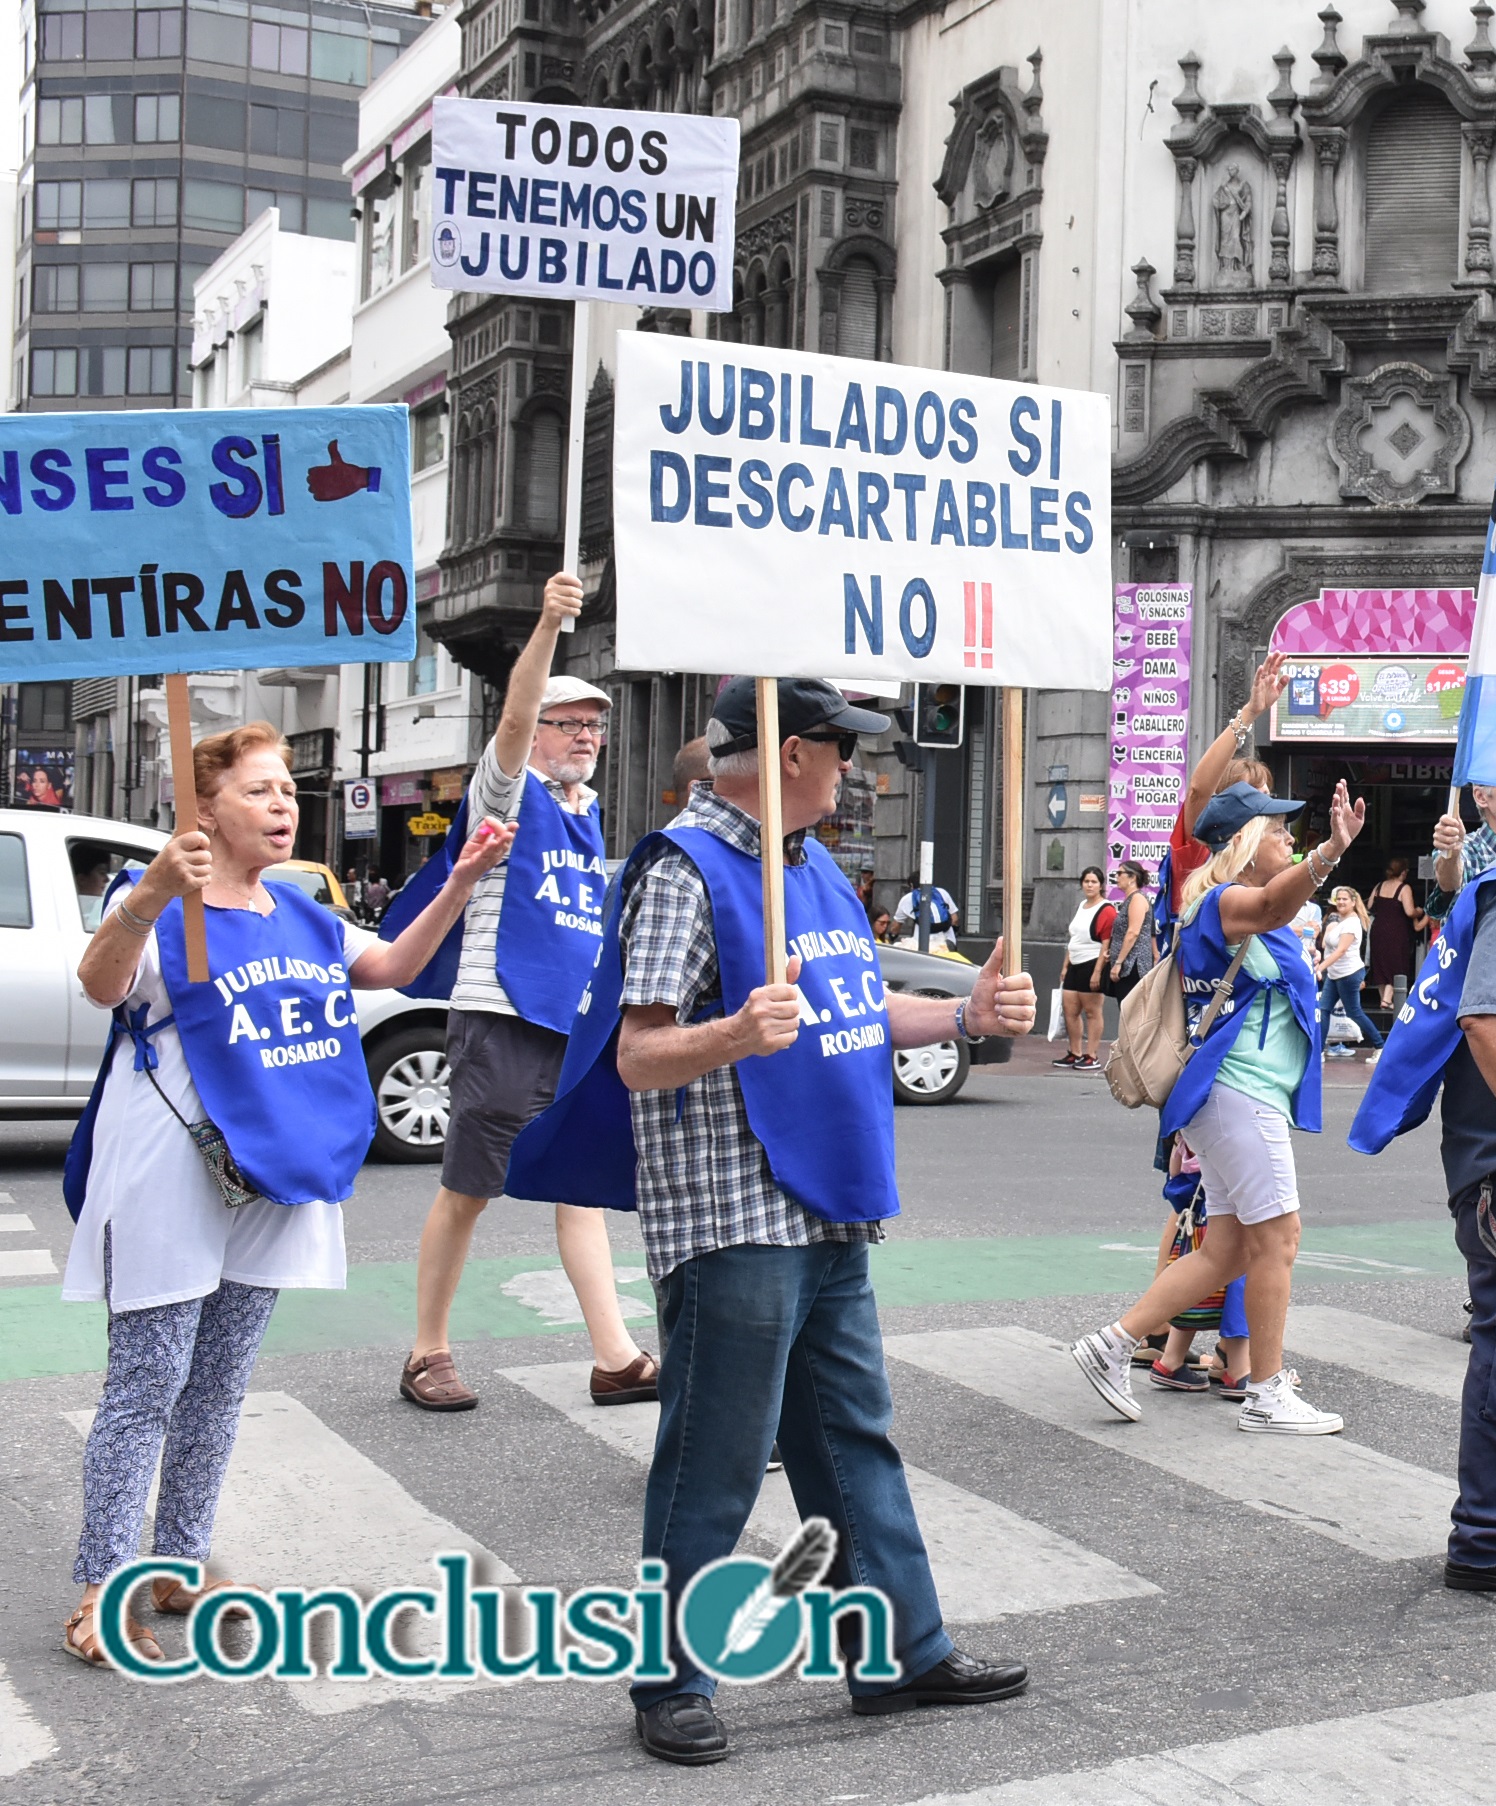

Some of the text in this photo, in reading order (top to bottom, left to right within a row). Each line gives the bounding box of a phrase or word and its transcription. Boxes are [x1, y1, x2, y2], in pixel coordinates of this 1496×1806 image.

[496, 112, 668, 176] TODOS
[436, 167, 716, 243] TENEMOS UN
[460, 232, 716, 296] JUBILADO
[659, 360, 1062, 480] JUBILADOS SI
[650, 450, 1093, 554] DESCARTABLES
[322, 560, 408, 637] NO
[1136, 591, 1189, 603] GOLOSINAS
[1140, 607, 1186, 618] Y SNACKS
[843, 573, 937, 659] NO
[1147, 629, 1177, 646] BEBÉ
[1144, 661, 1177, 675] DAMA
[1280, 665, 1320, 678] 10:43
[1144, 690, 1176, 704] NIÑOS
[1133, 718, 1185, 732] CABALLERO
[1132, 747, 1183, 761] LENCERÍA
[1134, 777, 1180, 788] BLANCO
[1136, 792, 1177, 803] HOGAR
[534, 874, 571, 906] A.
[214, 956, 347, 1007] JUBILADOS
[829, 977, 867, 1018] E.
[228, 990, 357, 1044] A. E. C.
[260, 1037, 341, 1068] ROSARIO
[820, 1023, 885, 1057] ROSARIO
